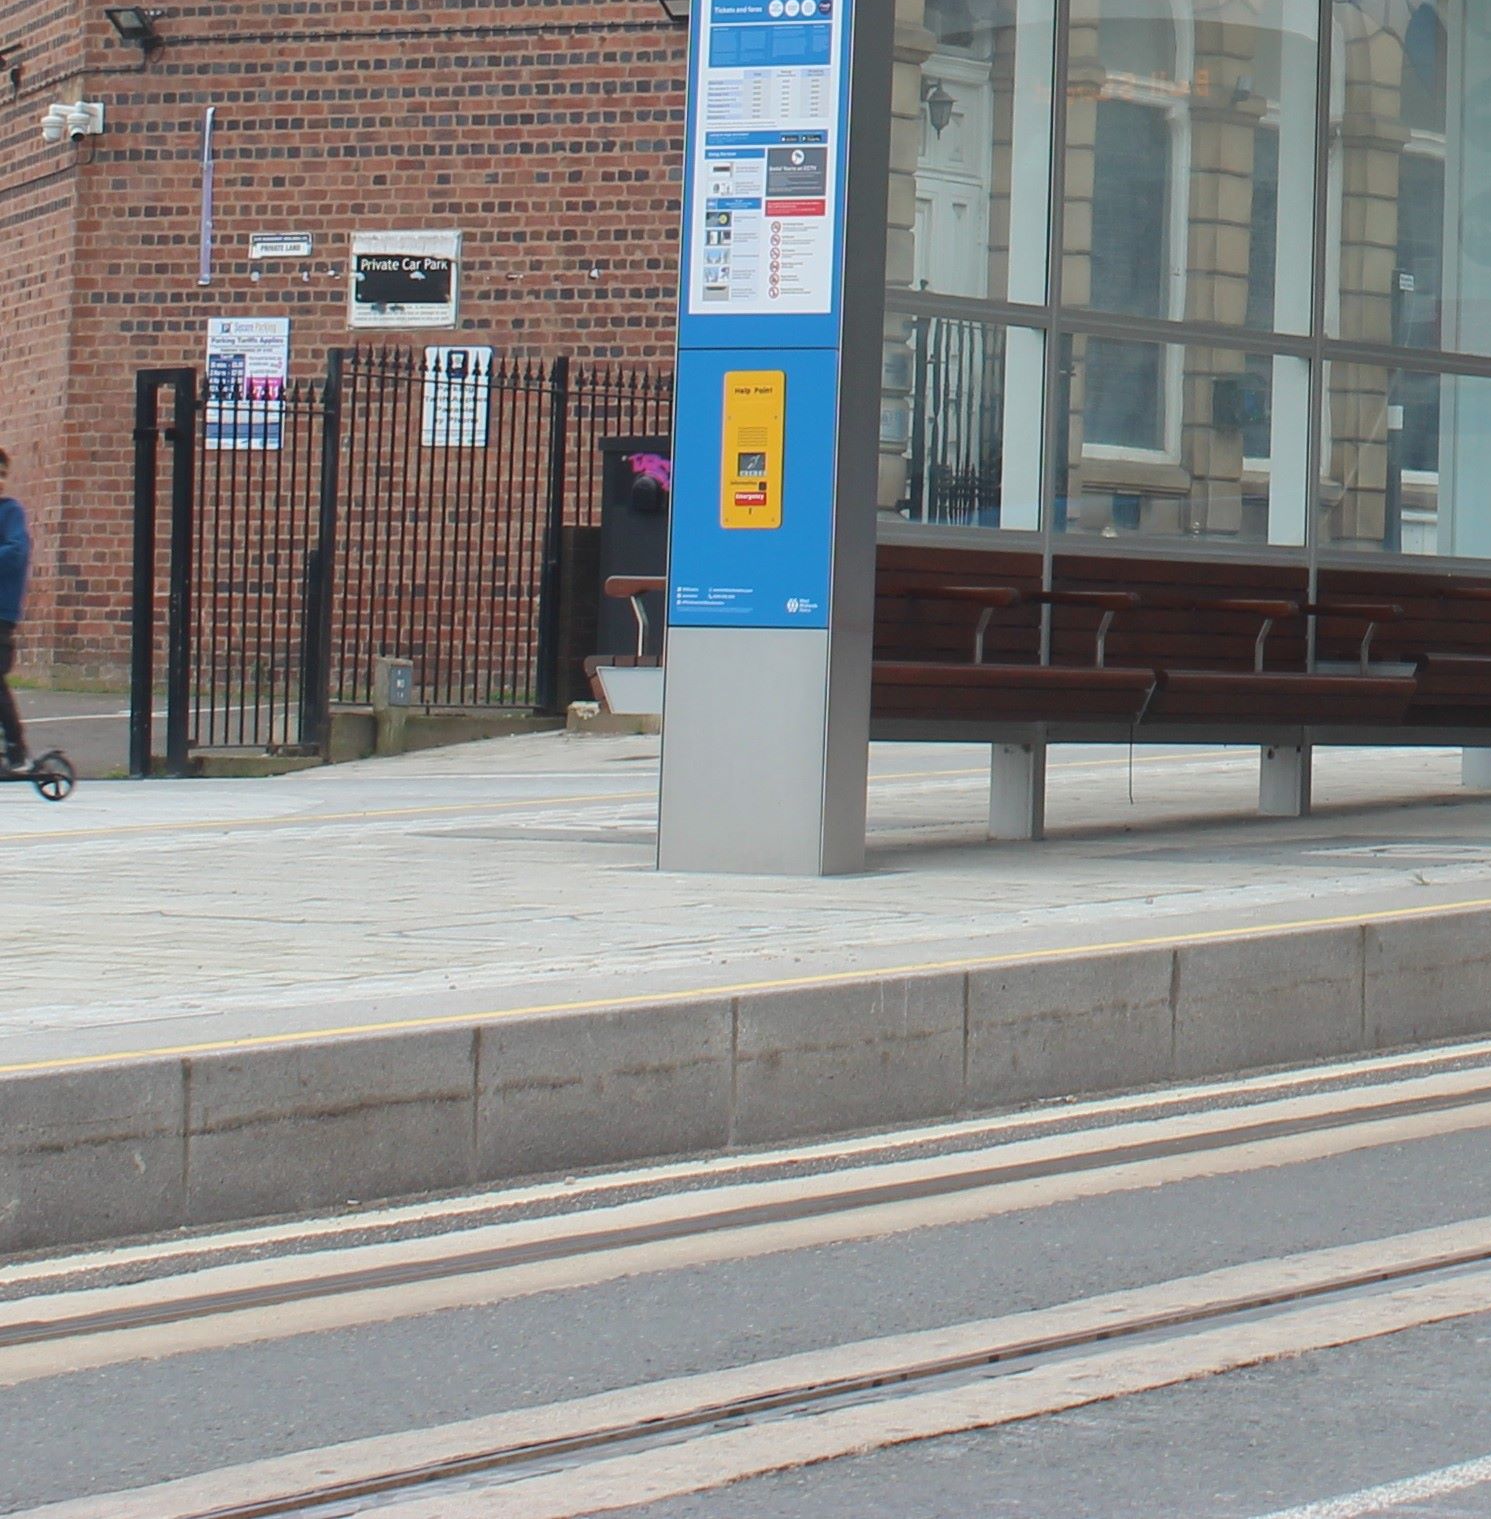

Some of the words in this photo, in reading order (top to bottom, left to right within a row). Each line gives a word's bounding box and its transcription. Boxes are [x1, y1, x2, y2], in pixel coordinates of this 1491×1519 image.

[361, 259, 400, 271] Private
[402, 258, 421, 271] Car
[424, 259, 448, 270] Park
